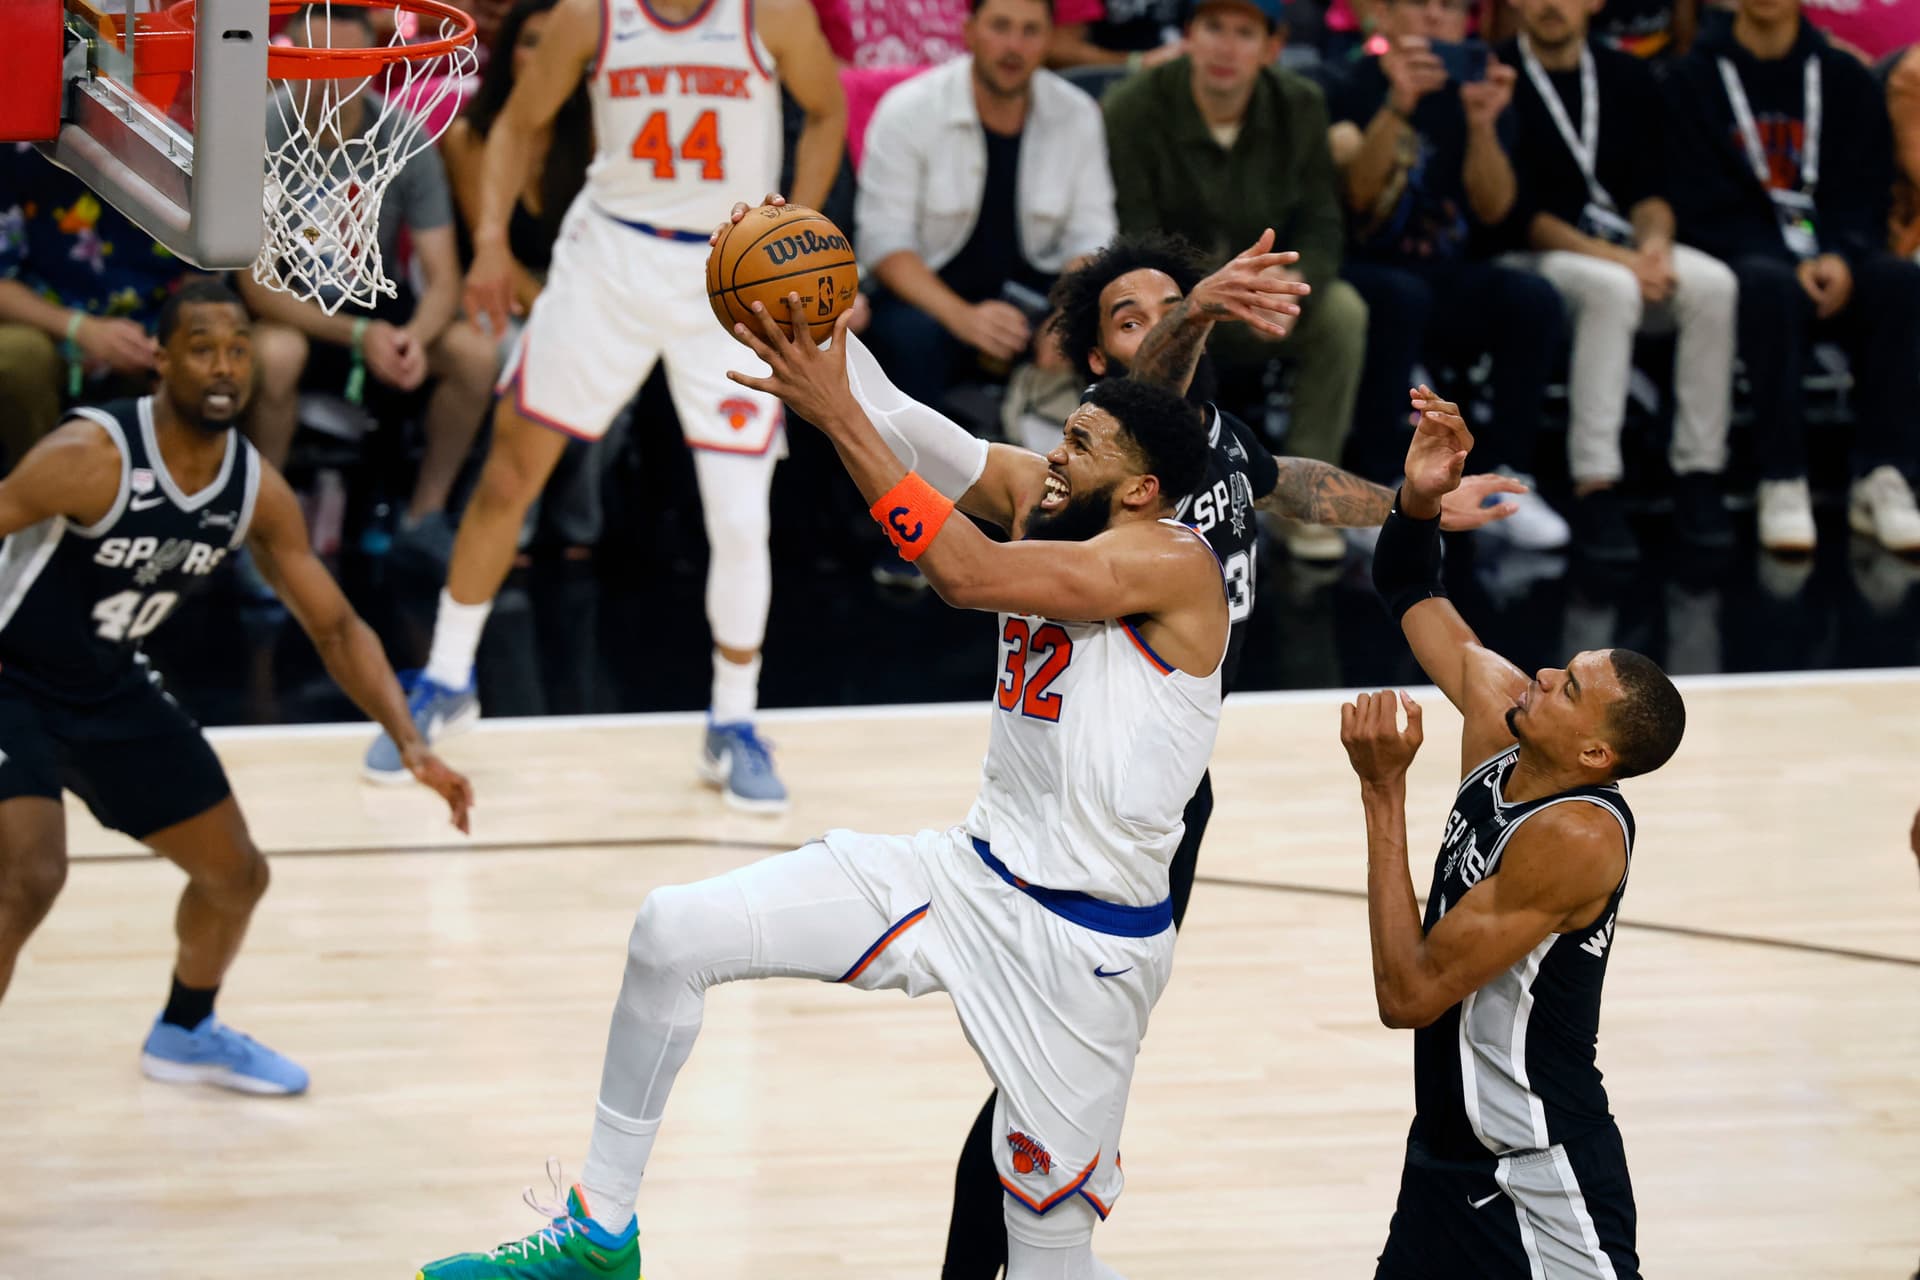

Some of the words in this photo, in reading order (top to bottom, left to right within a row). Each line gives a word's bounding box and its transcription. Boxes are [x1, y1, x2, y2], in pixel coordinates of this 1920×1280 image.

[608, 65, 672, 99] NEW
[673, 64, 751, 99] YORK
[632, 108, 724, 181] 44
[763, 229, 850, 265] Wilson
[91, 590, 179, 641] 40
[1225, 549, 1258, 624] 3
[997, 616, 1074, 724] 32
